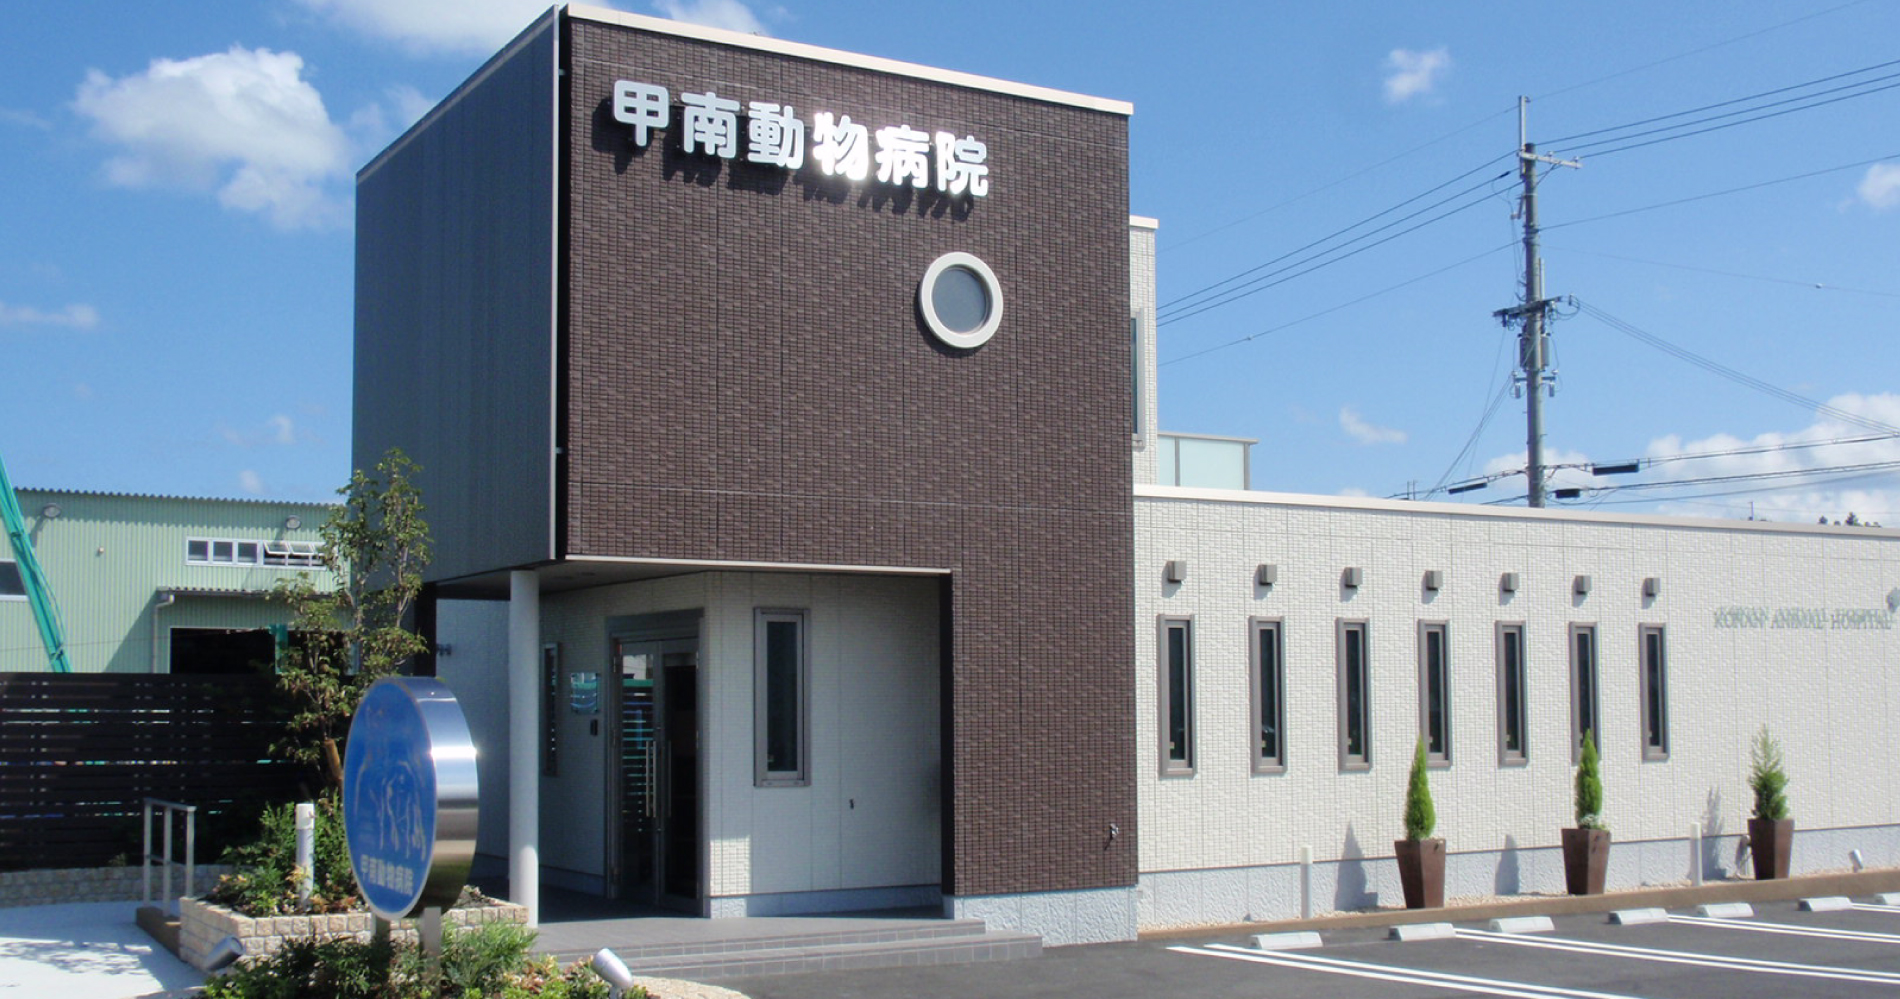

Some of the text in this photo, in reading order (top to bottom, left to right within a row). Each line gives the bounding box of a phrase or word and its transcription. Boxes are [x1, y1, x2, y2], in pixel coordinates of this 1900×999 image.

[613, 79, 989, 197] 甲南動物病院
